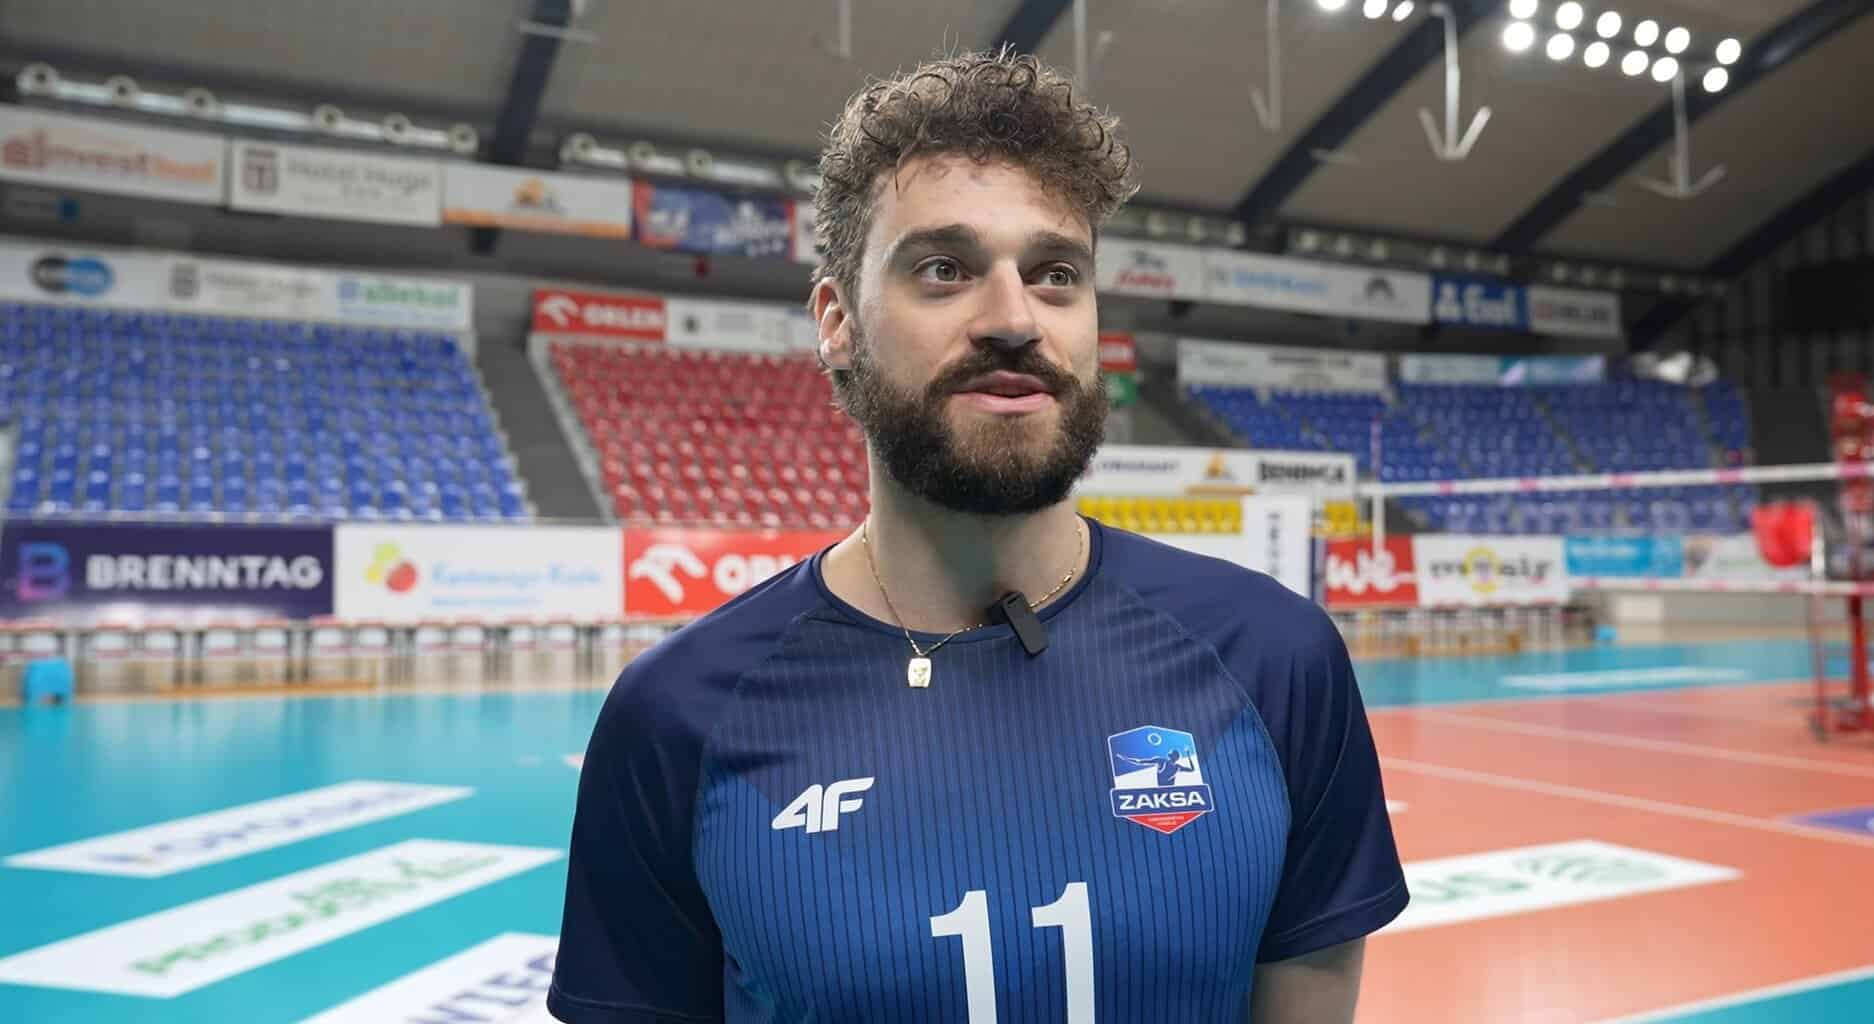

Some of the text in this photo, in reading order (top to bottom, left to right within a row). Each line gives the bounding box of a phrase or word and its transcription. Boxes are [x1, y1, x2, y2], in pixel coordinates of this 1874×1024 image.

[86, 554, 324, 589] BRENNTAG
[771, 776, 875, 834] 4F
[1118, 790, 1206, 811] ZAKSA
[929, 881, 1096, 1024] 11
